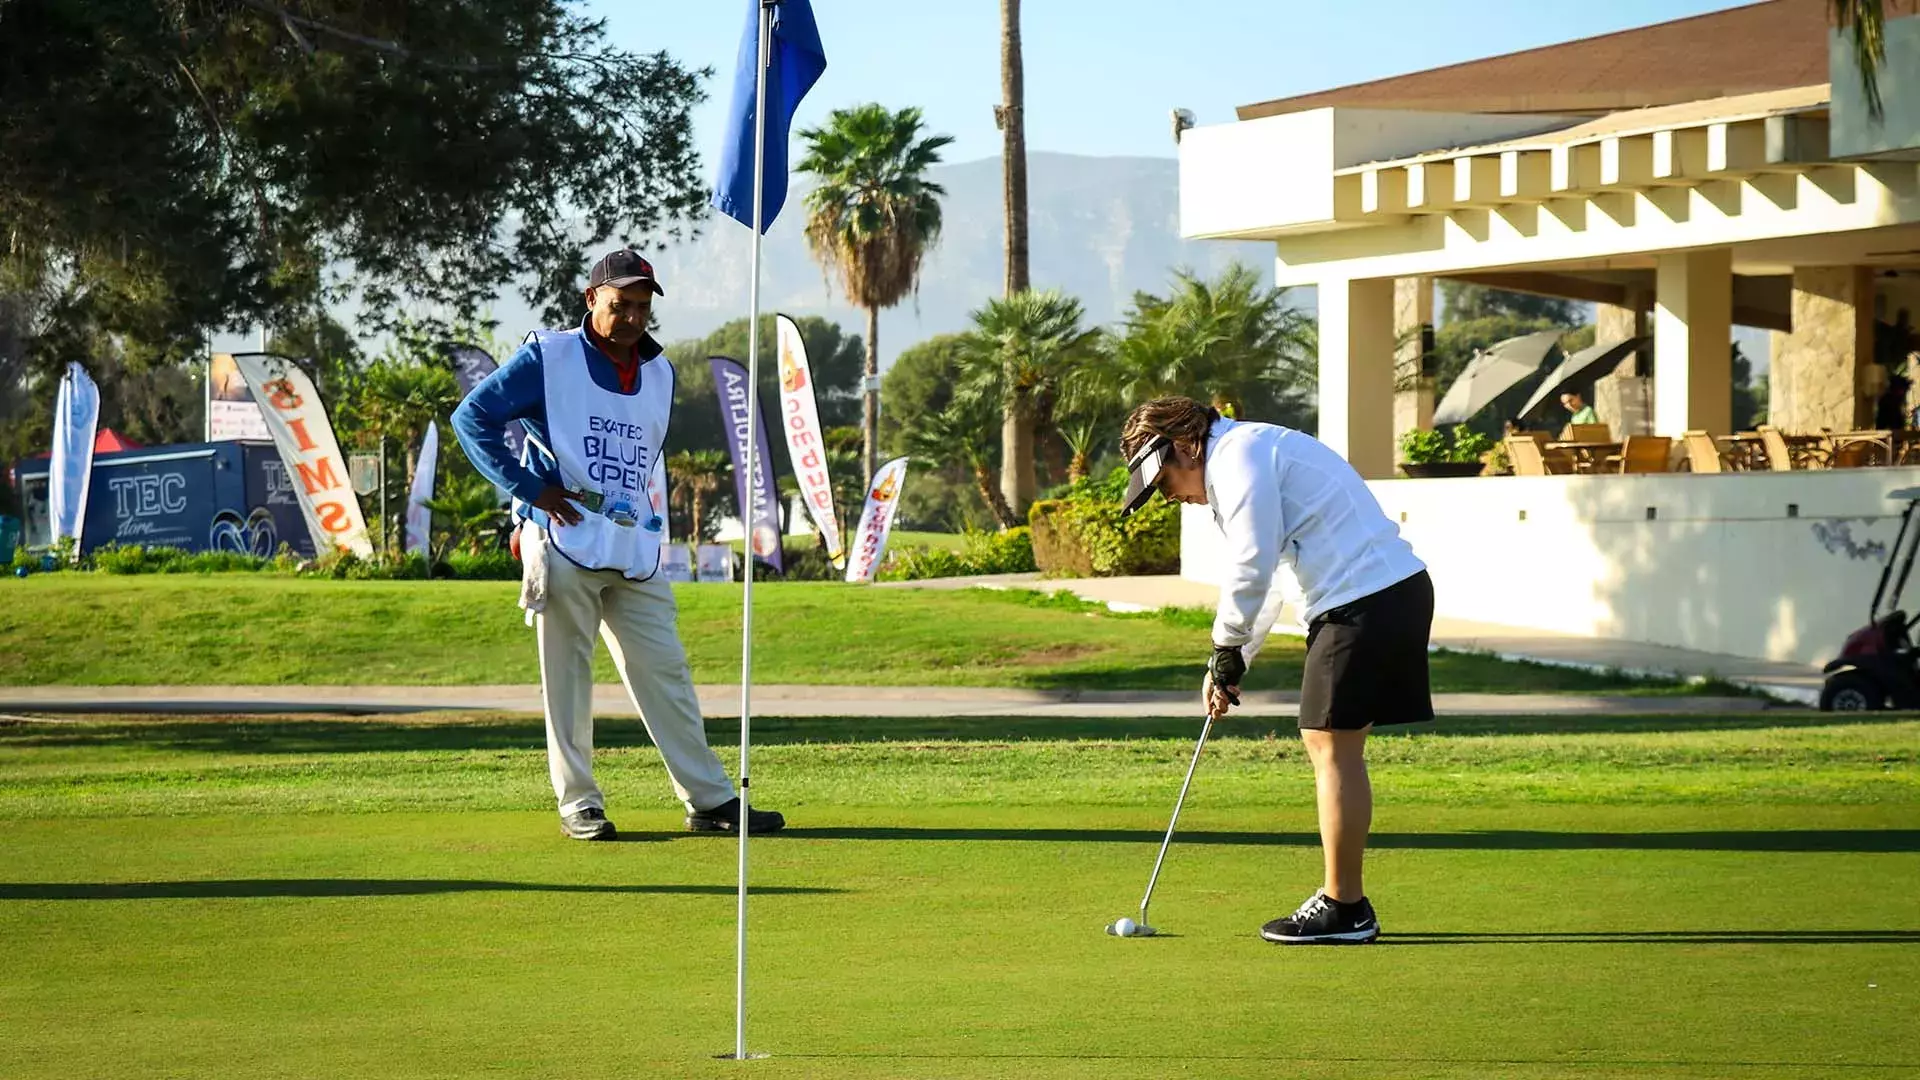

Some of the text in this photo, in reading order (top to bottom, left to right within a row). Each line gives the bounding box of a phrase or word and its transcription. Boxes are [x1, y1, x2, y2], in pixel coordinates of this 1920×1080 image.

[589, 416, 643, 440] EXATEC
[583, 435, 648, 469] BLUE
[264, 459, 293, 492] TE
[588, 461, 646, 494] OPEN
[109, 473, 187, 518] TEC
